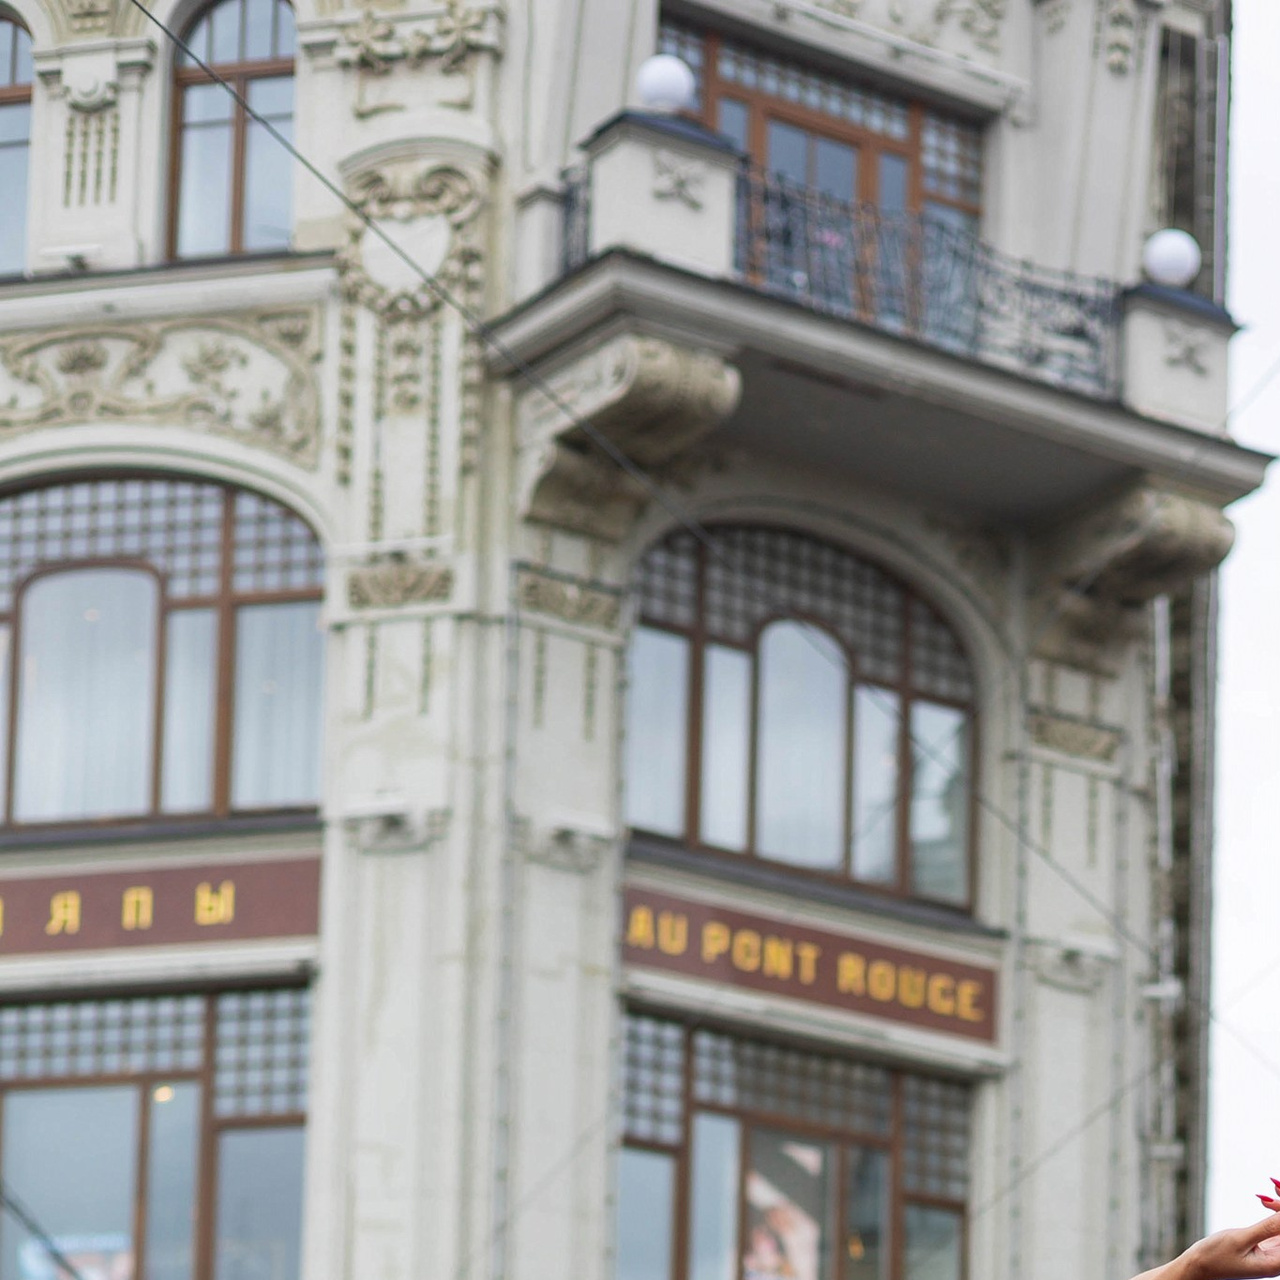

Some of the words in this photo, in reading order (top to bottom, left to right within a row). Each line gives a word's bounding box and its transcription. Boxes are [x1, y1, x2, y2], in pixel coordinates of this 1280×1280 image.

[0, 880, 236, 936] ЯПЫ
[626, 904, 689, 956] AU
[701, 920, 822, 985] PONT
[837, 951, 985, 1023] ROUGE
